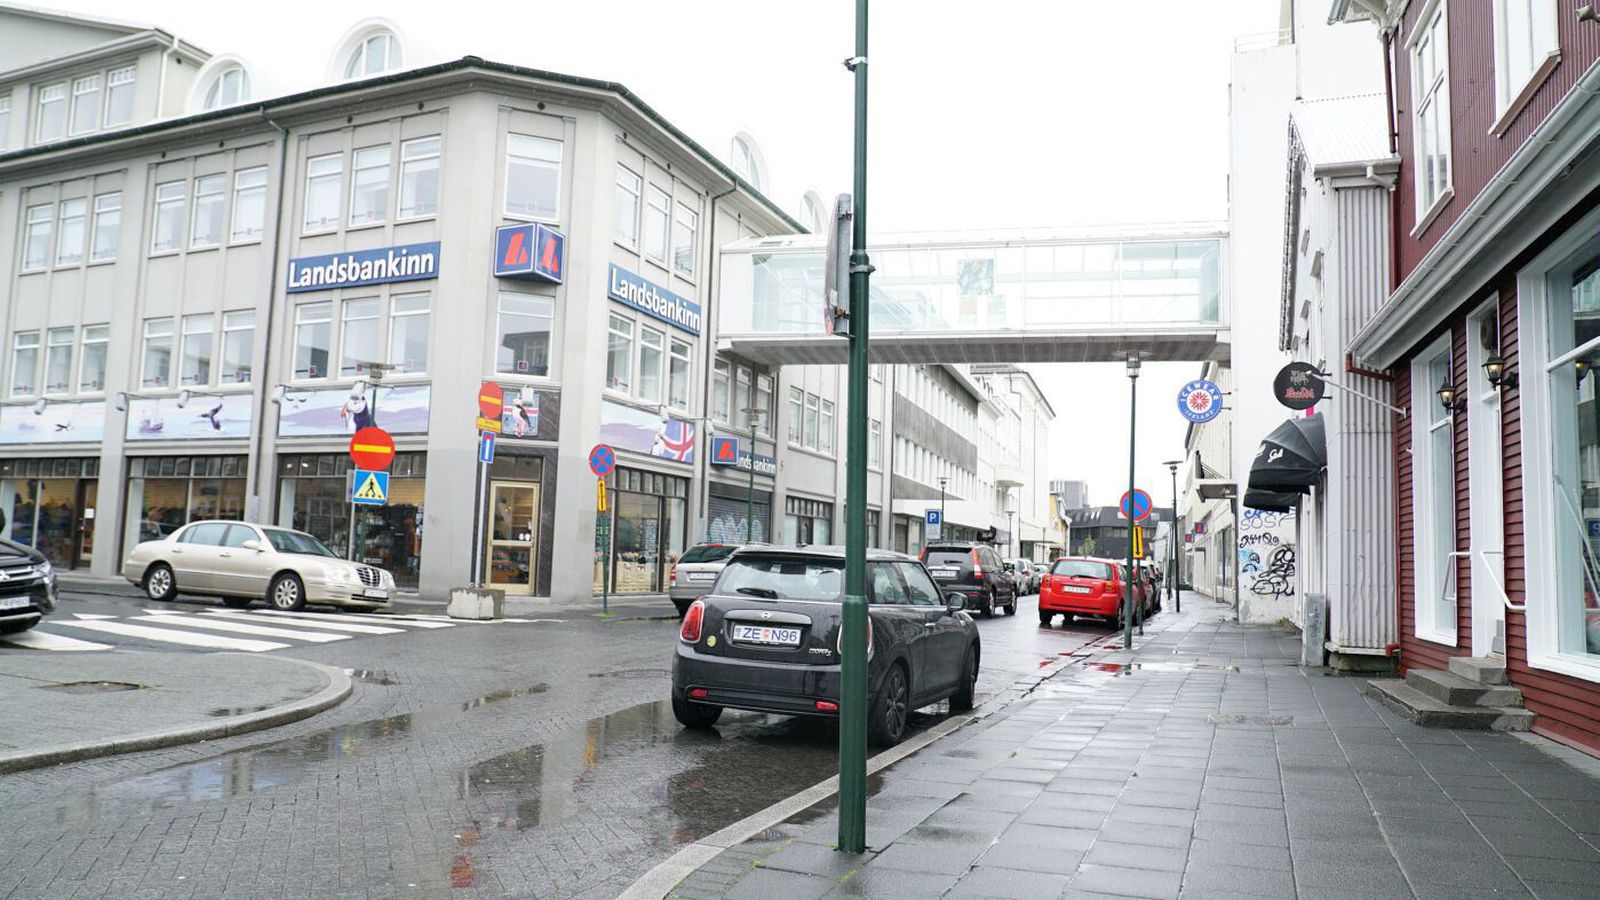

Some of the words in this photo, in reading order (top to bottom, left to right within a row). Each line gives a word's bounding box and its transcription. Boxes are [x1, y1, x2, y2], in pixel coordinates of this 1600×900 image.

[288, 249, 434, 288] Landsbankinn
[611, 269, 701, 331] Landsbankinn
[1180, 383, 1219, 402] ICEWEAR
[737, 453, 776, 474] andsankinn
[929, 512, 938, 523] P
[742, 627, 761, 639] ZE
[771, 629, 798, 642] N96
